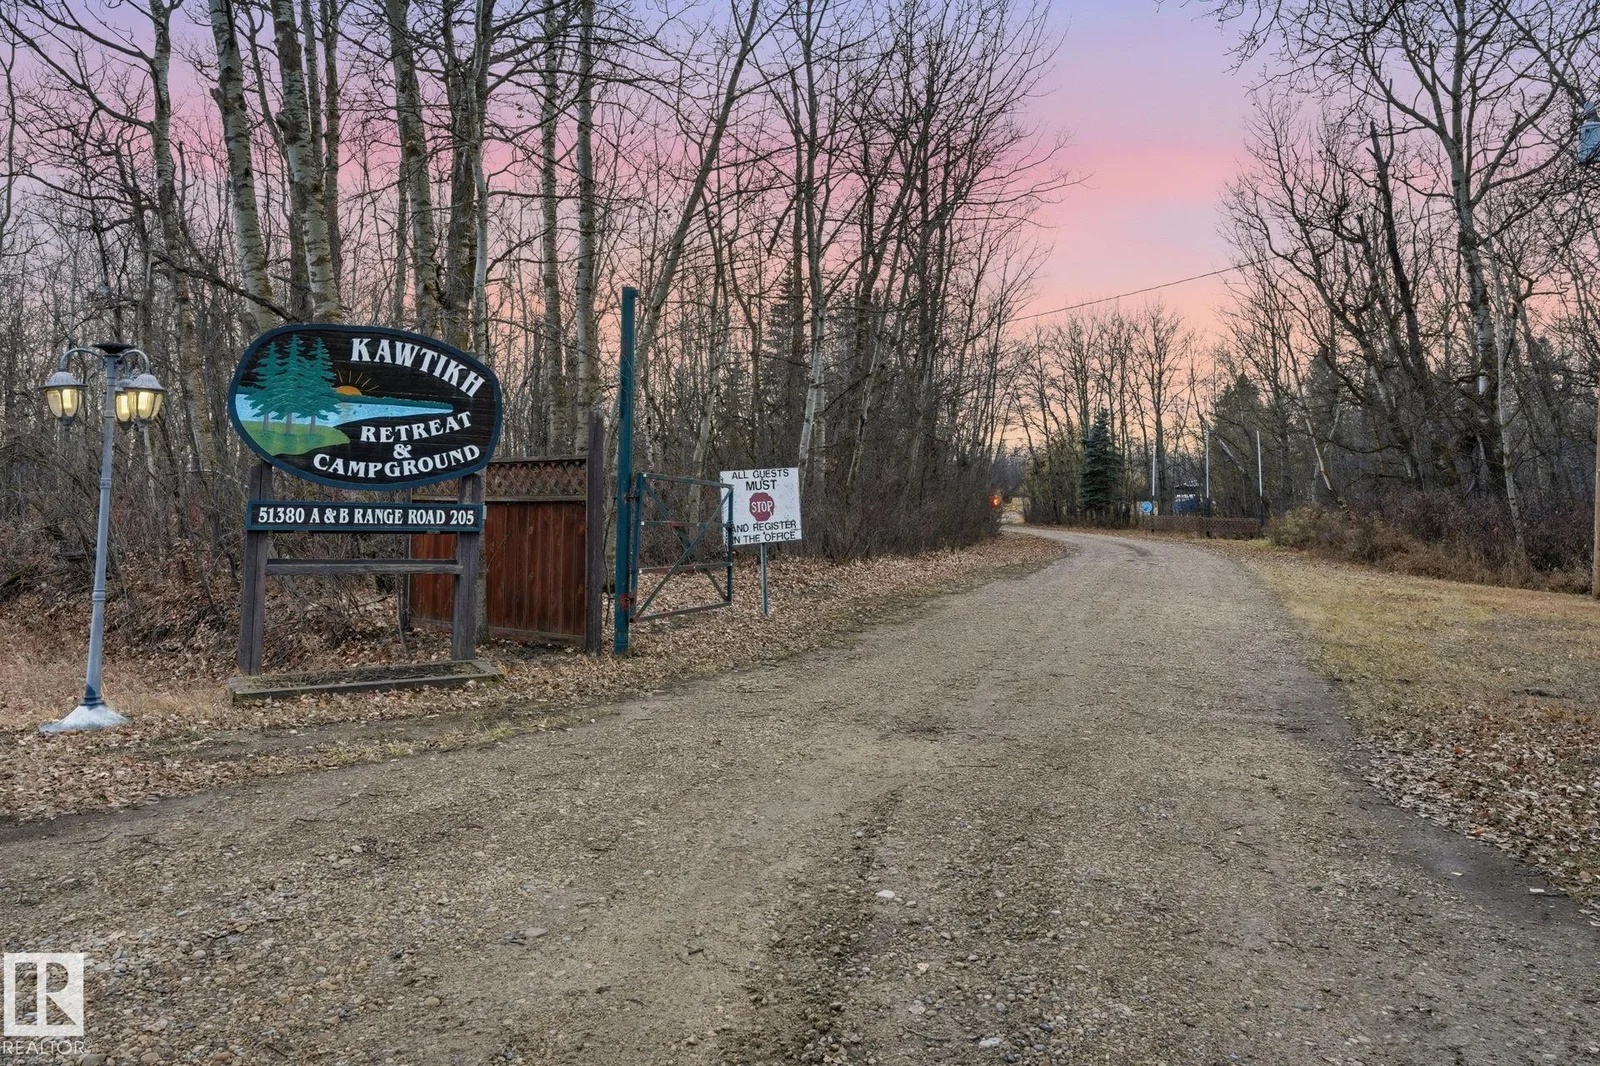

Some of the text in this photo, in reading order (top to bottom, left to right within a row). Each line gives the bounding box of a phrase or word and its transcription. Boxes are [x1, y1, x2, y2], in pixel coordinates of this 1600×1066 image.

[350, 338, 485, 398] KAWTIKH
[359, 411, 472, 443] RETREAT
[393, 443, 412, 459] &
[313, 444, 480, 478] CAMPGROUND
[731, 469, 789, 480] ALL GUESTS
[745, 479, 777, 491] MUST
[751, 500, 773, 514] STOP
[258, 507, 475, 525] 51380 A & B RANGE ROAD 205
[731, 520, 797, 533] AND REGISTER
[743, 534, 761, 542] THE
[764, 531, 796, 542] OFFICE
